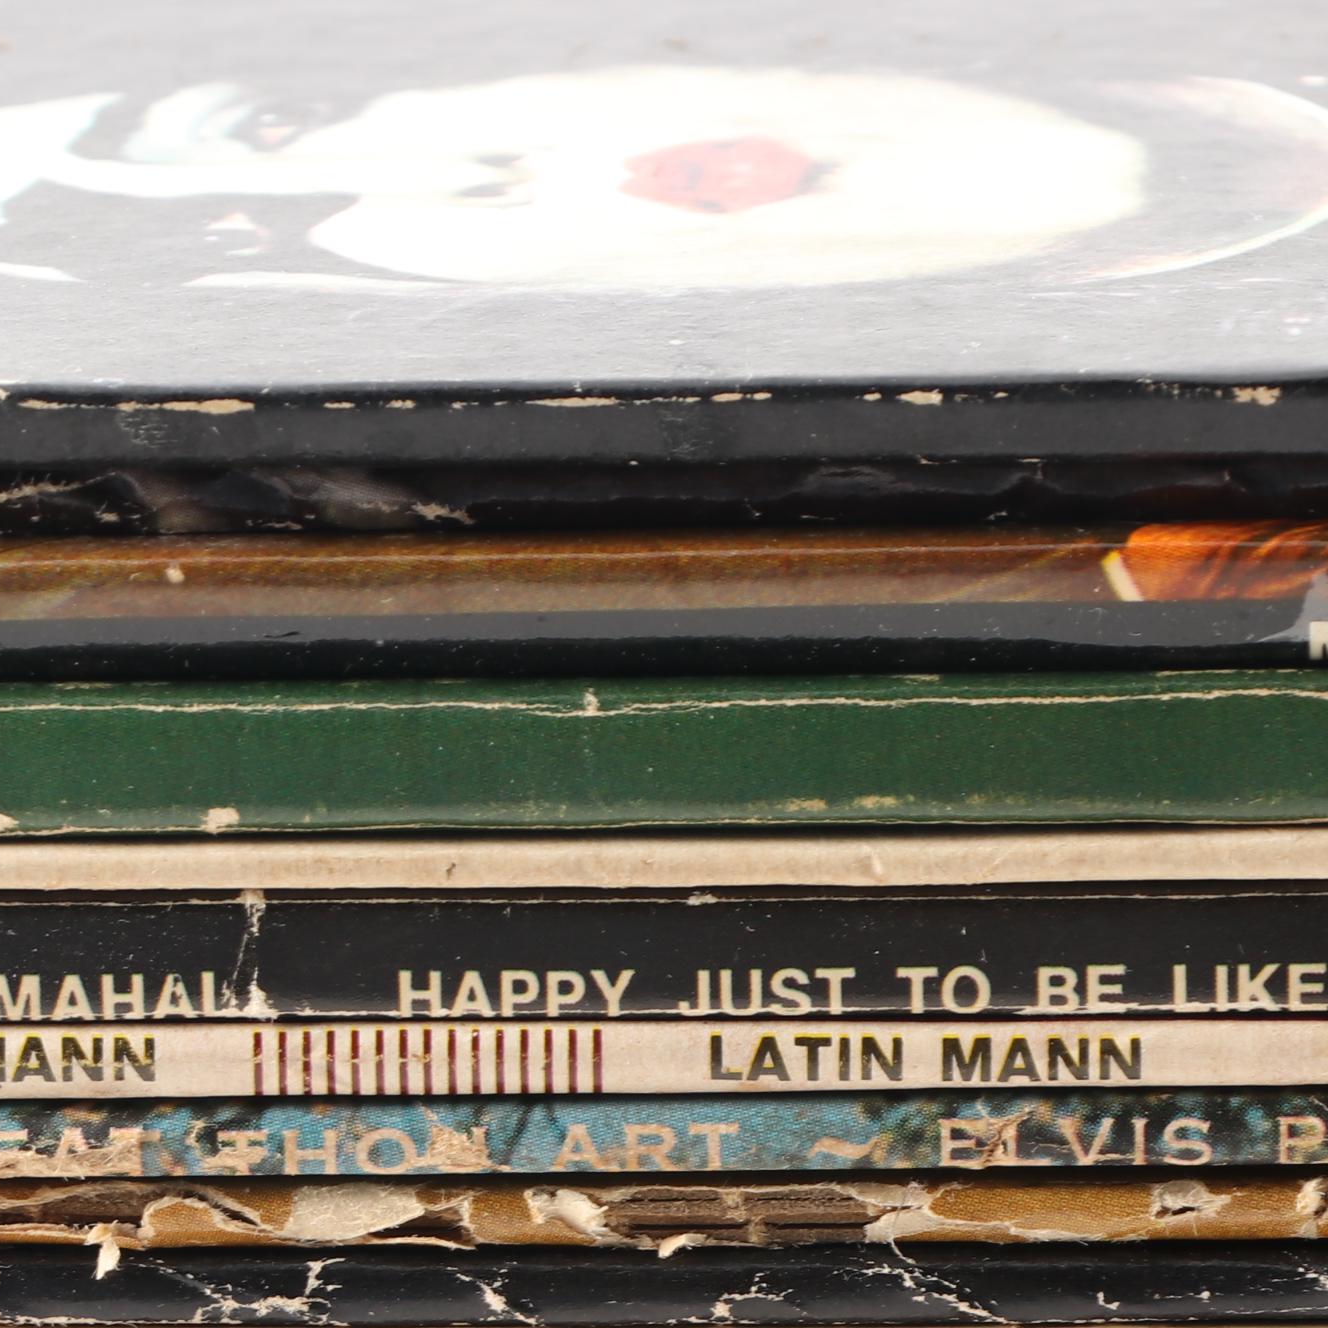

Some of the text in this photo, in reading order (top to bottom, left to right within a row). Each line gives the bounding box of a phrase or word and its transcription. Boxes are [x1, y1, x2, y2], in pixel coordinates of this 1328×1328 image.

[397, 967, 637, 1018] HAPPY
[676, 966, 857, 1016] JUST
[895, 964, 992, 1015] TO
[1035, 963, 1127, 1014] BE
[1173, 962, 1326, 1013] LIKE
[710, 1034, 1144, 1083] LATIN MANN
[552, 1121, 742, 1172] ART
[937, 1115, 1214, 1167] ELVIS
